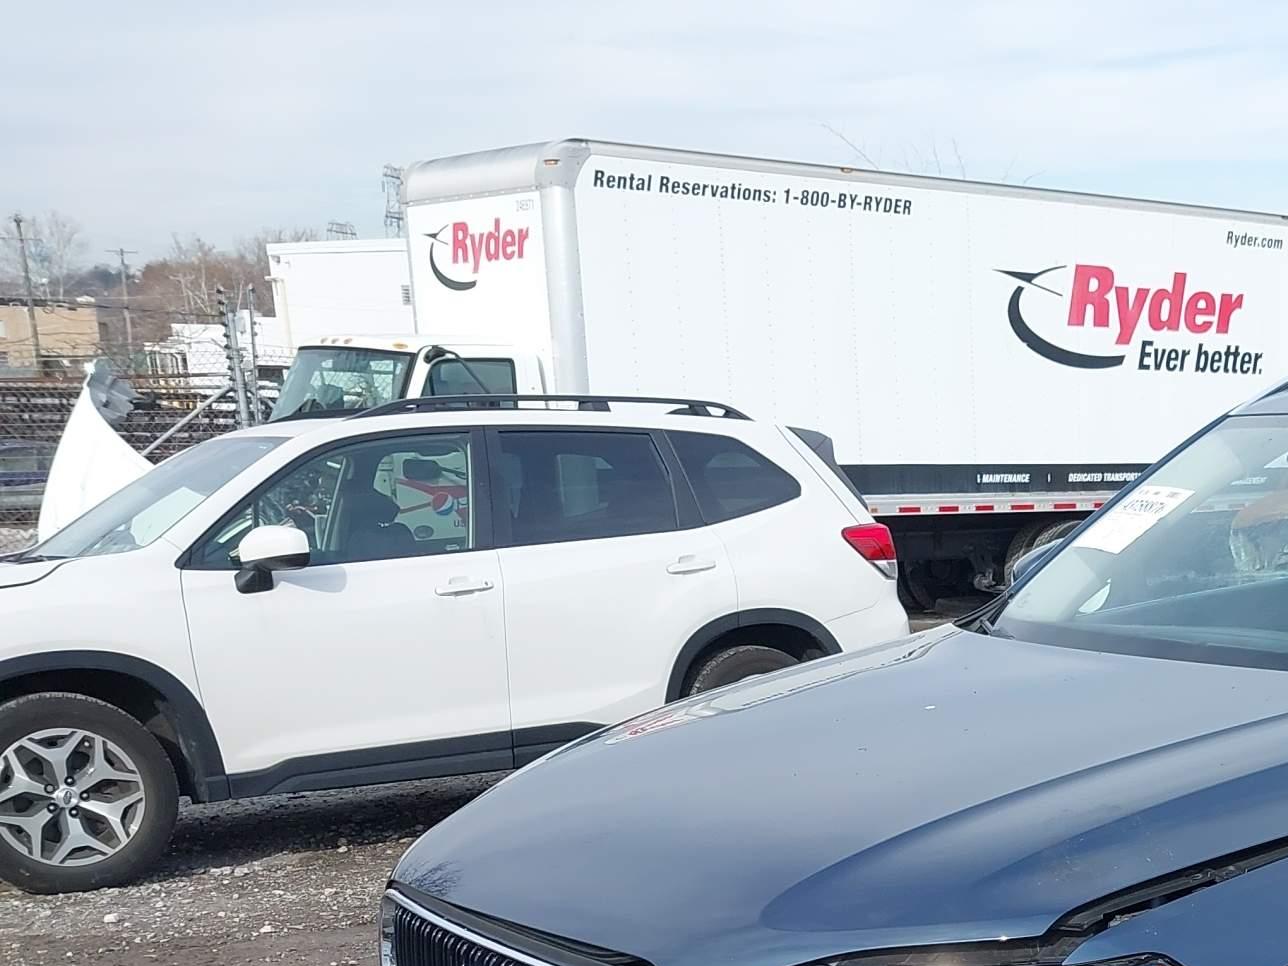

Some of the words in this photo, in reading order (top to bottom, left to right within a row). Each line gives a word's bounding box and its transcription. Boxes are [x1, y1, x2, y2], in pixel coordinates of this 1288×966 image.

[593, 169, 652, 191] Rental
[659, 175, 777, 203] Reservations:
[783, 187, 912, 215] 1-800-BY-RYDER
[451, 217, 529, 273] Ryder
[1226, 230, 1284, 250] Ryder.com
[1067, 263, 1244, 345] Ryder
[1138, 340, 1190, 372] Ever
[1195, 340, 1264, 375] better.
[981, 473, 1031, 483] MAINTENANCE
[1068, 472, 1102, 482] DEDICATED
